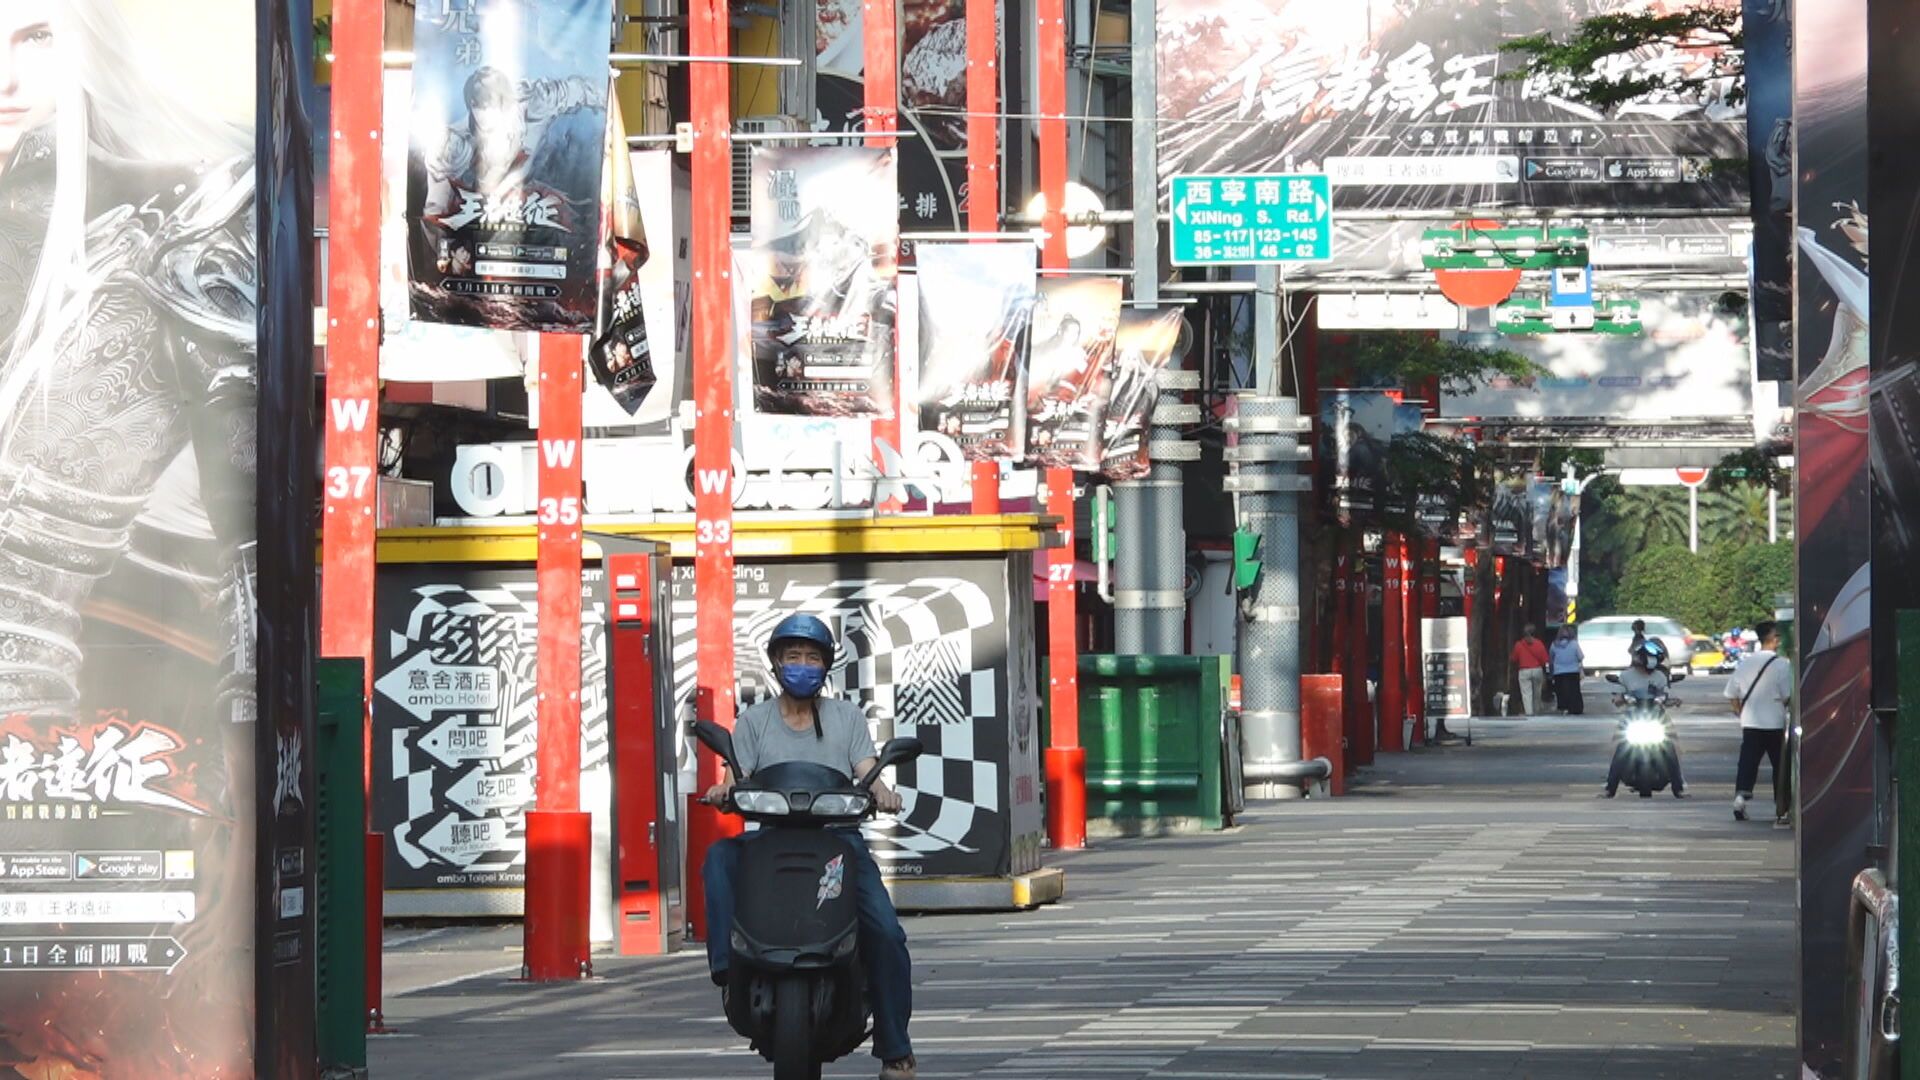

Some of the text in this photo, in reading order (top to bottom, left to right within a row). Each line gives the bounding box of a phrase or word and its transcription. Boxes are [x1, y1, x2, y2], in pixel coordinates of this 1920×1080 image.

[1627, 166, 1675, 179] App Store
[1186, 179, 1313, 206] 西寧南路
[1256, 210, 1273, 224] S.
[1287, 210, 1313, 223] Rd.
[332, 399, 370, 432] W
[542, 439, 576, 468] W
[328, 467, 371, 498] 37
[699, 470, 729, 494] W
[540, 499, 578, 525] 35
[697, 521, 730, 544] 33
[1049, 565, 1073, 581] 27
[408, 668, 491, 691] 意舍酒店
[448, 730, 487, 748] 問吧
[477, 778, 516, 797] 吃吧
[450, 823, 490, 845] 聽吧
[11, 863, 66, 878] App Store
[98, 863, 158, 877] Google play
[437, 875, 464, 884] amba
[467, 872, 497, 884] Taipei
